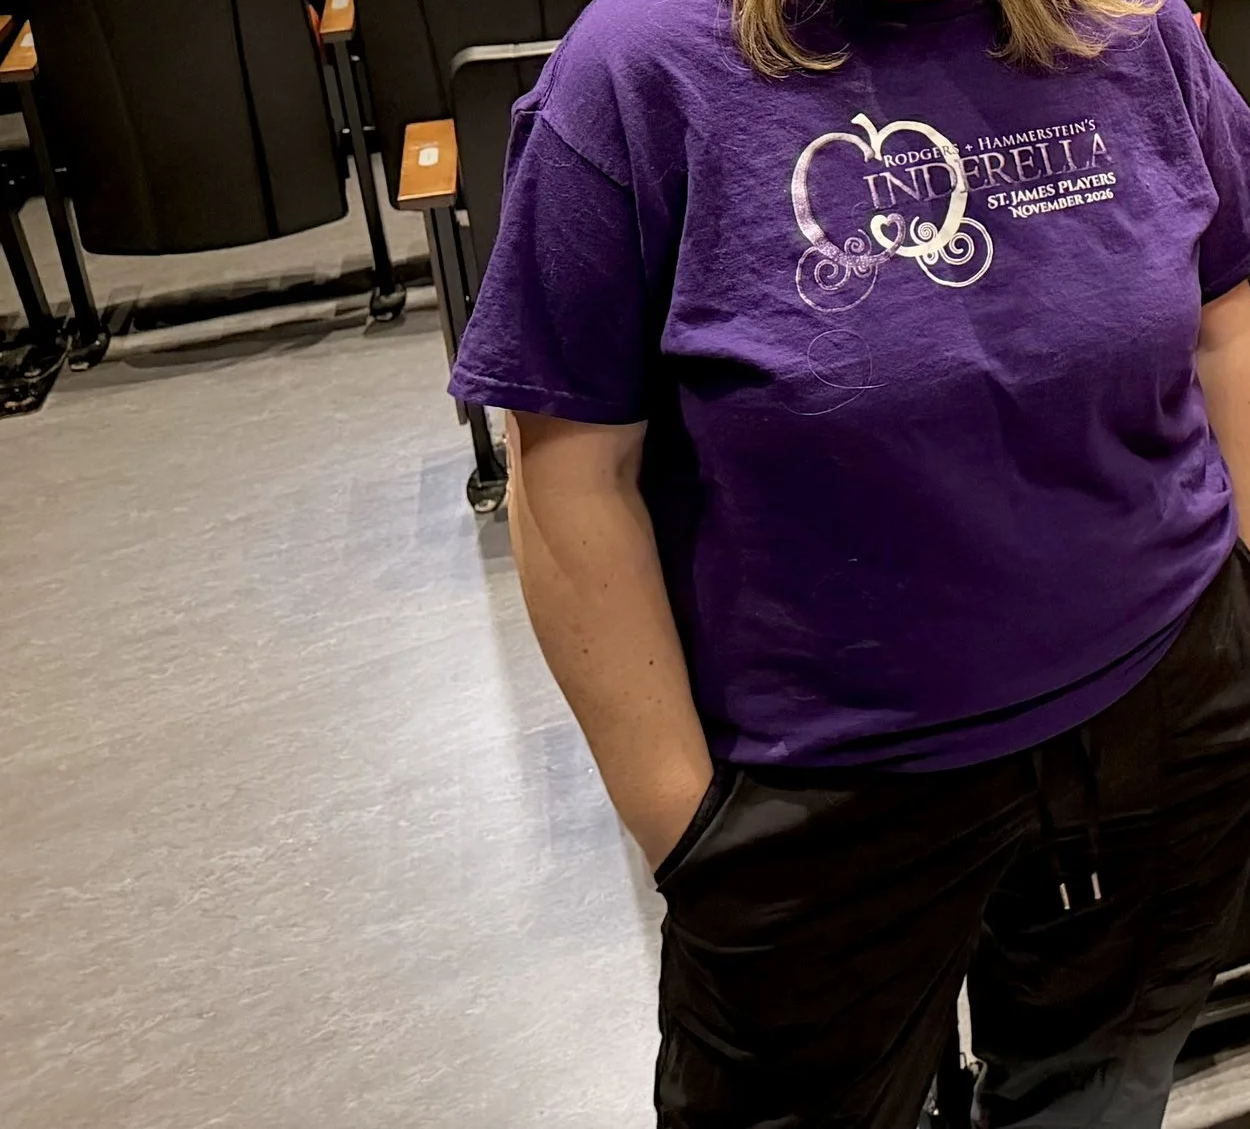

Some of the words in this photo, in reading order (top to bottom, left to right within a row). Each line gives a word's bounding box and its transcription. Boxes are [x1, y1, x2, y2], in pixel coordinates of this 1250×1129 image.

[884, 143, 960, 168] RODGERS
[978, 118, 1096, 151] HAMMERSTEIN'S
[987, 192, 1010, 210] ST.
[1010, 183, 1056, 206] JAMES
[1057, 171, 1117, 195] PLAYERS
[1008, 193, 1085, 219] NOVEMBER
[1085, 188, 1114, 204] 2026
